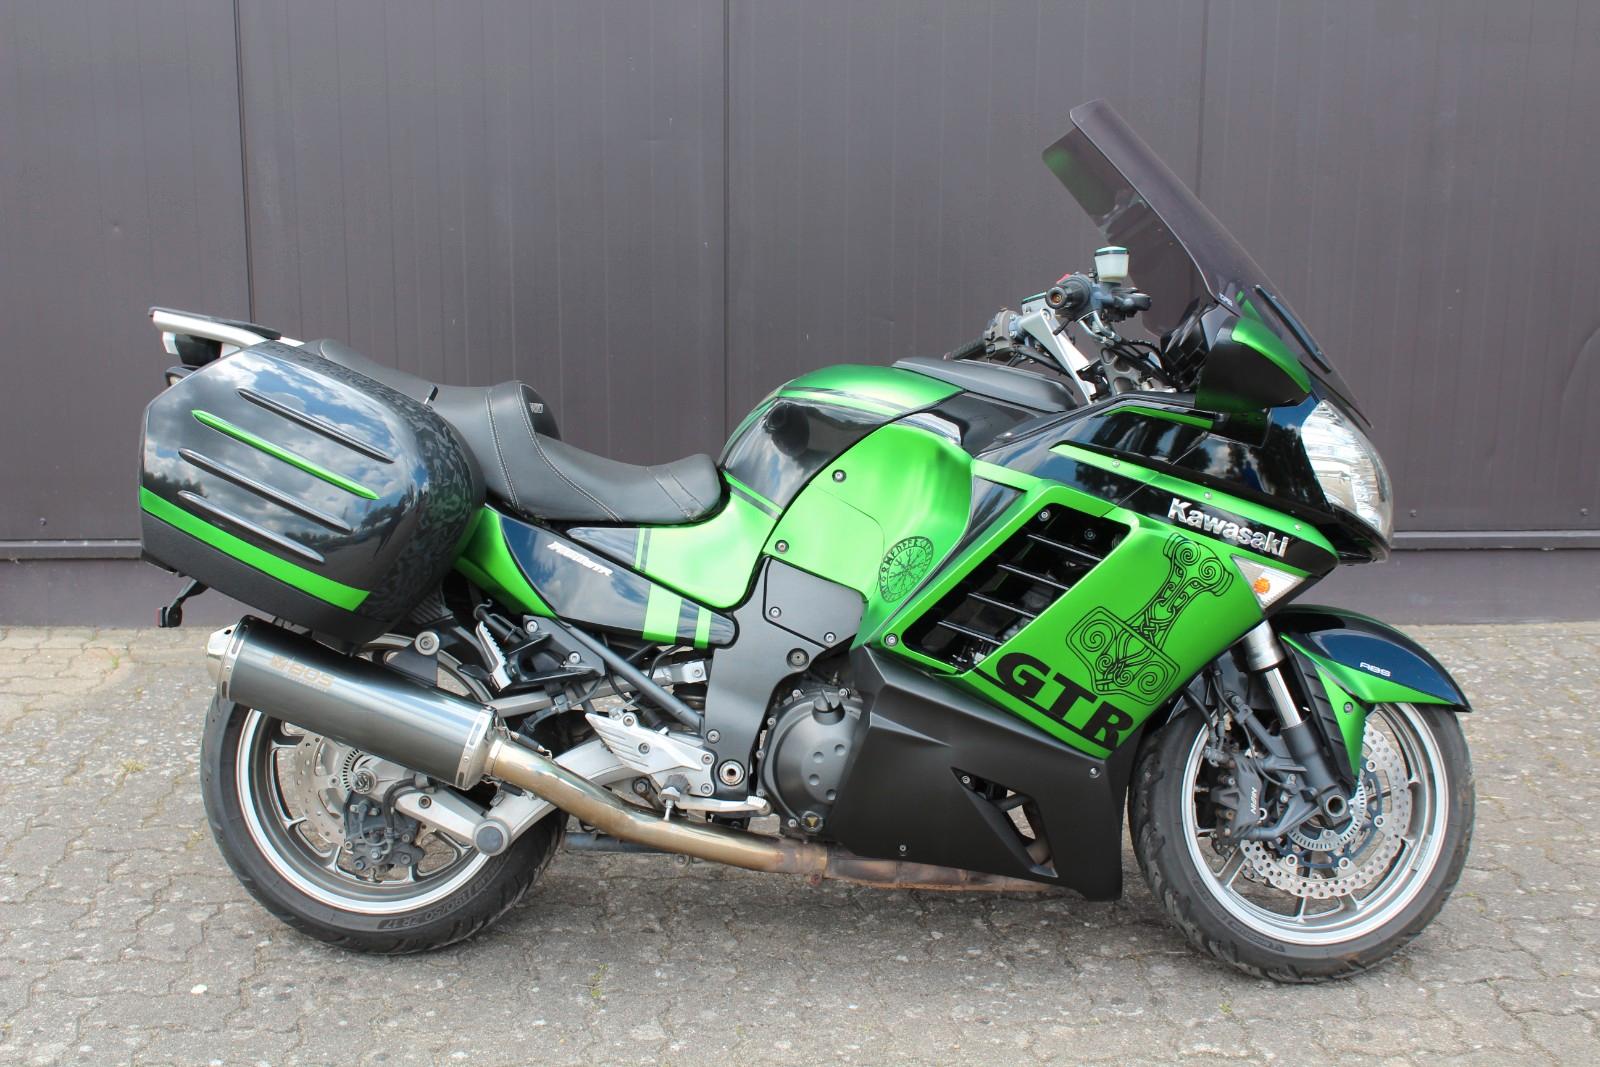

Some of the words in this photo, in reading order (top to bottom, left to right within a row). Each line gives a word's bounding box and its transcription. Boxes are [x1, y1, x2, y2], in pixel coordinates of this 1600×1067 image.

[1168, 498, 1289, 558] Kawasaki
[1360, 661, 1391, 677] ABS
[996, 652, 1134, 751] GTR
